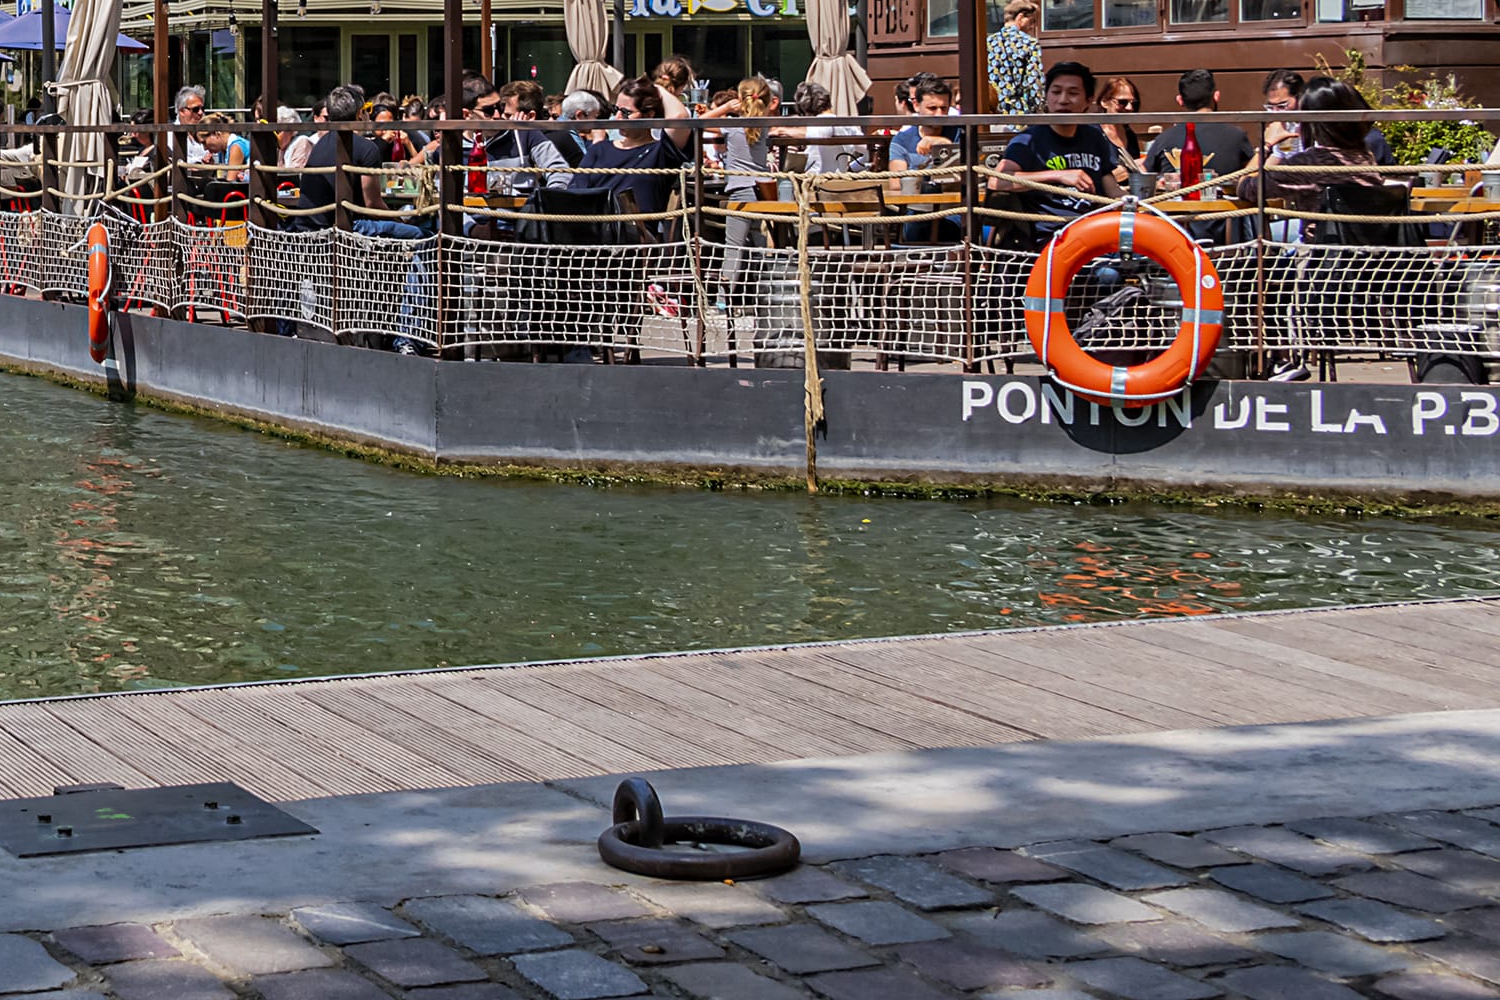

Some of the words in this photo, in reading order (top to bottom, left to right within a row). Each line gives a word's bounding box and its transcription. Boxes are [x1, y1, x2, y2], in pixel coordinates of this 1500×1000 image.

[1046, 155, 1067, 171] SKI
[1064, 152, 1101, 171] TIGNES
[1214, 395, 1290, 432] DE
[1311, 389, 1387, 434] LA
